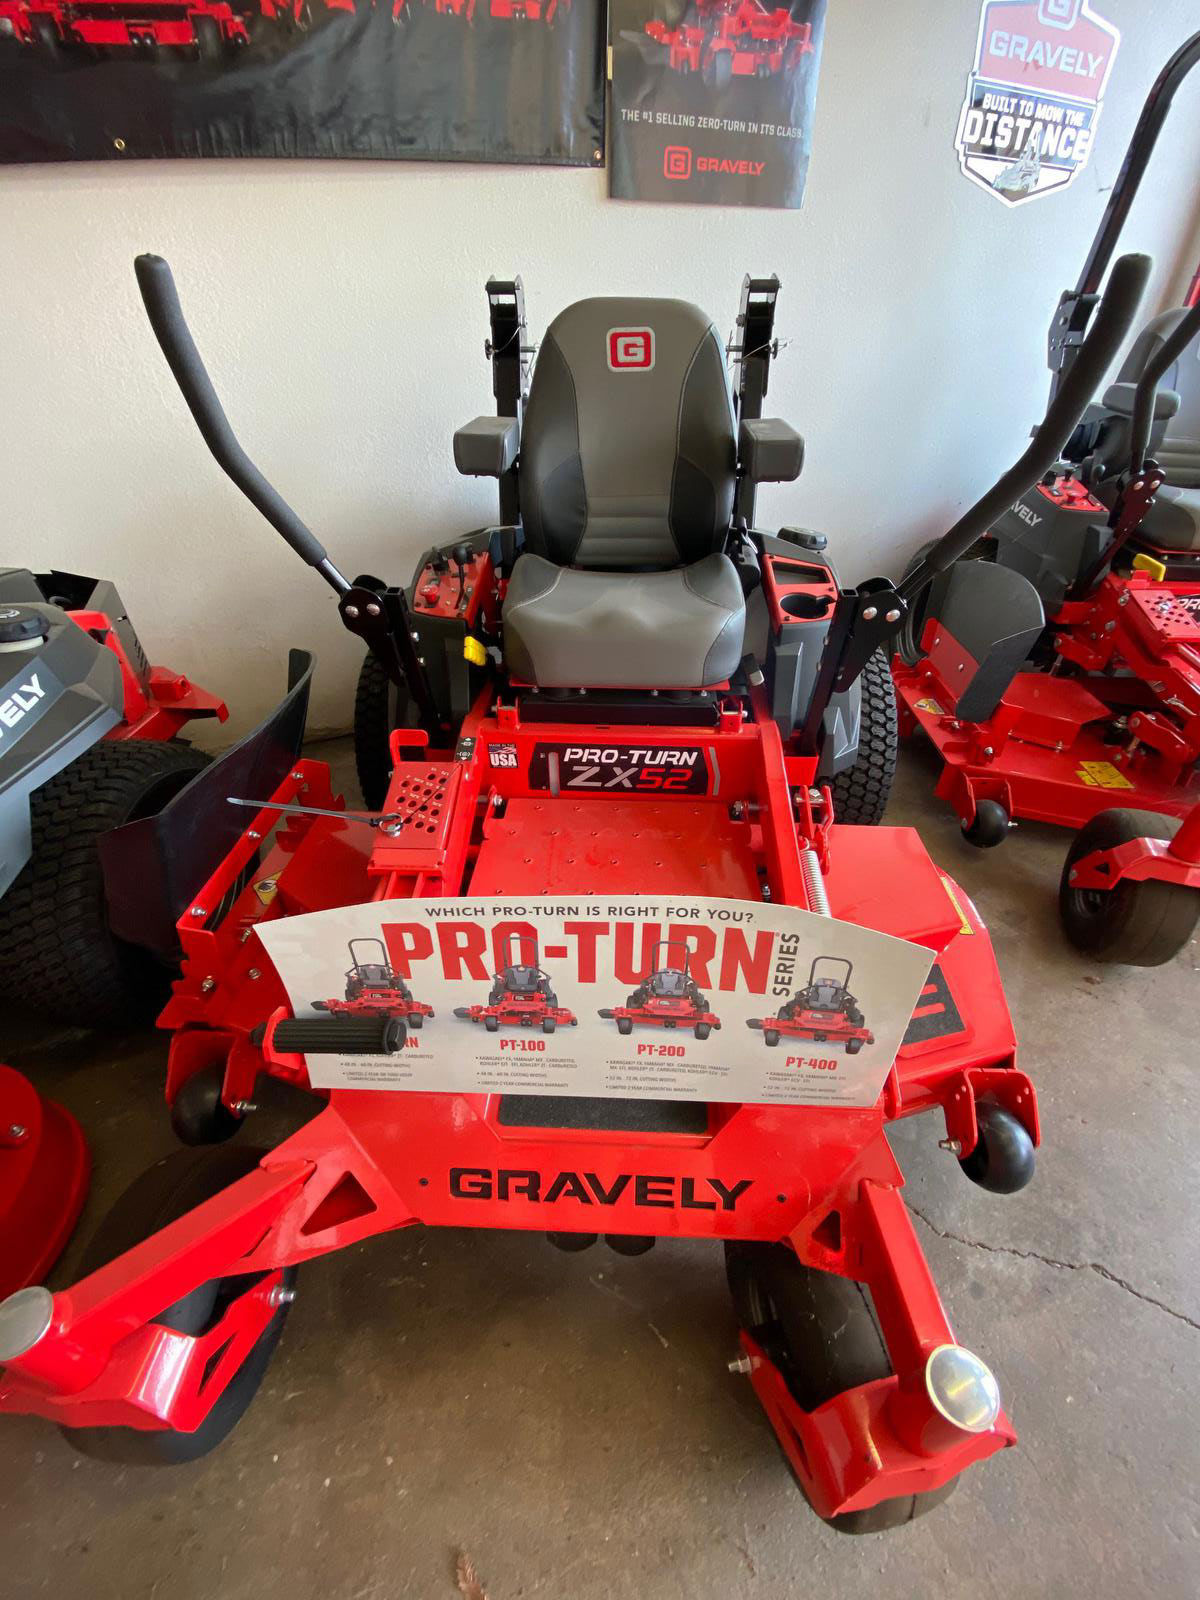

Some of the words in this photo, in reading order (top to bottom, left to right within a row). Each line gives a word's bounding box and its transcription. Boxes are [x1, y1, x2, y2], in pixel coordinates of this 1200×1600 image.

[989, 30, 1104, 79] GRAVELY
[621, 109, 640, 122] THE
[642, 111, 654, 123] #1
[656, 112, 695, 127] SELLING
[697, 116, 746, 133] ZERO-TURN
[748, 122, 758, 134] IN
[760, 122, 775, 136] ITS
[983, 93, 1018, 113] BUILT
[1019, 99, 1035, 116] TO
[1035, 104, 1064, 122] MOW
[1065, 109, 1086, 127] THE
[962, 110, 1092, 161] DISTANCE
[696, 157, 767, 176] GRAVELY
[1010, 499, 1043, 527] VELY
[0, 673, 46, 739] ELY
[490, 753, 517, 766] USA
[563, 748, 698, 766] PRO-TURN
[567, 765, 693, 789] ZX52
[425, 906, 485, 917] WHICH
[493, 906, 579, 916] PRO-TURN
[586, 906, 600, 916] IS
[607, 906, 659, 917] RIGHT
[666, 907, 700, 919] FOR
[706, 909, 754, 923] YOU?
[380, 921, 775, 995] PRO-TURN
[772, 933, 800, 997] SERIES
[500, 1039, 545, 1051] PT-100
[637, 1043, 685, 1057] PT-200
[786, 1056, 838, 1070] PT-400
[450, 1167, 755, 1211] GRAVELY
